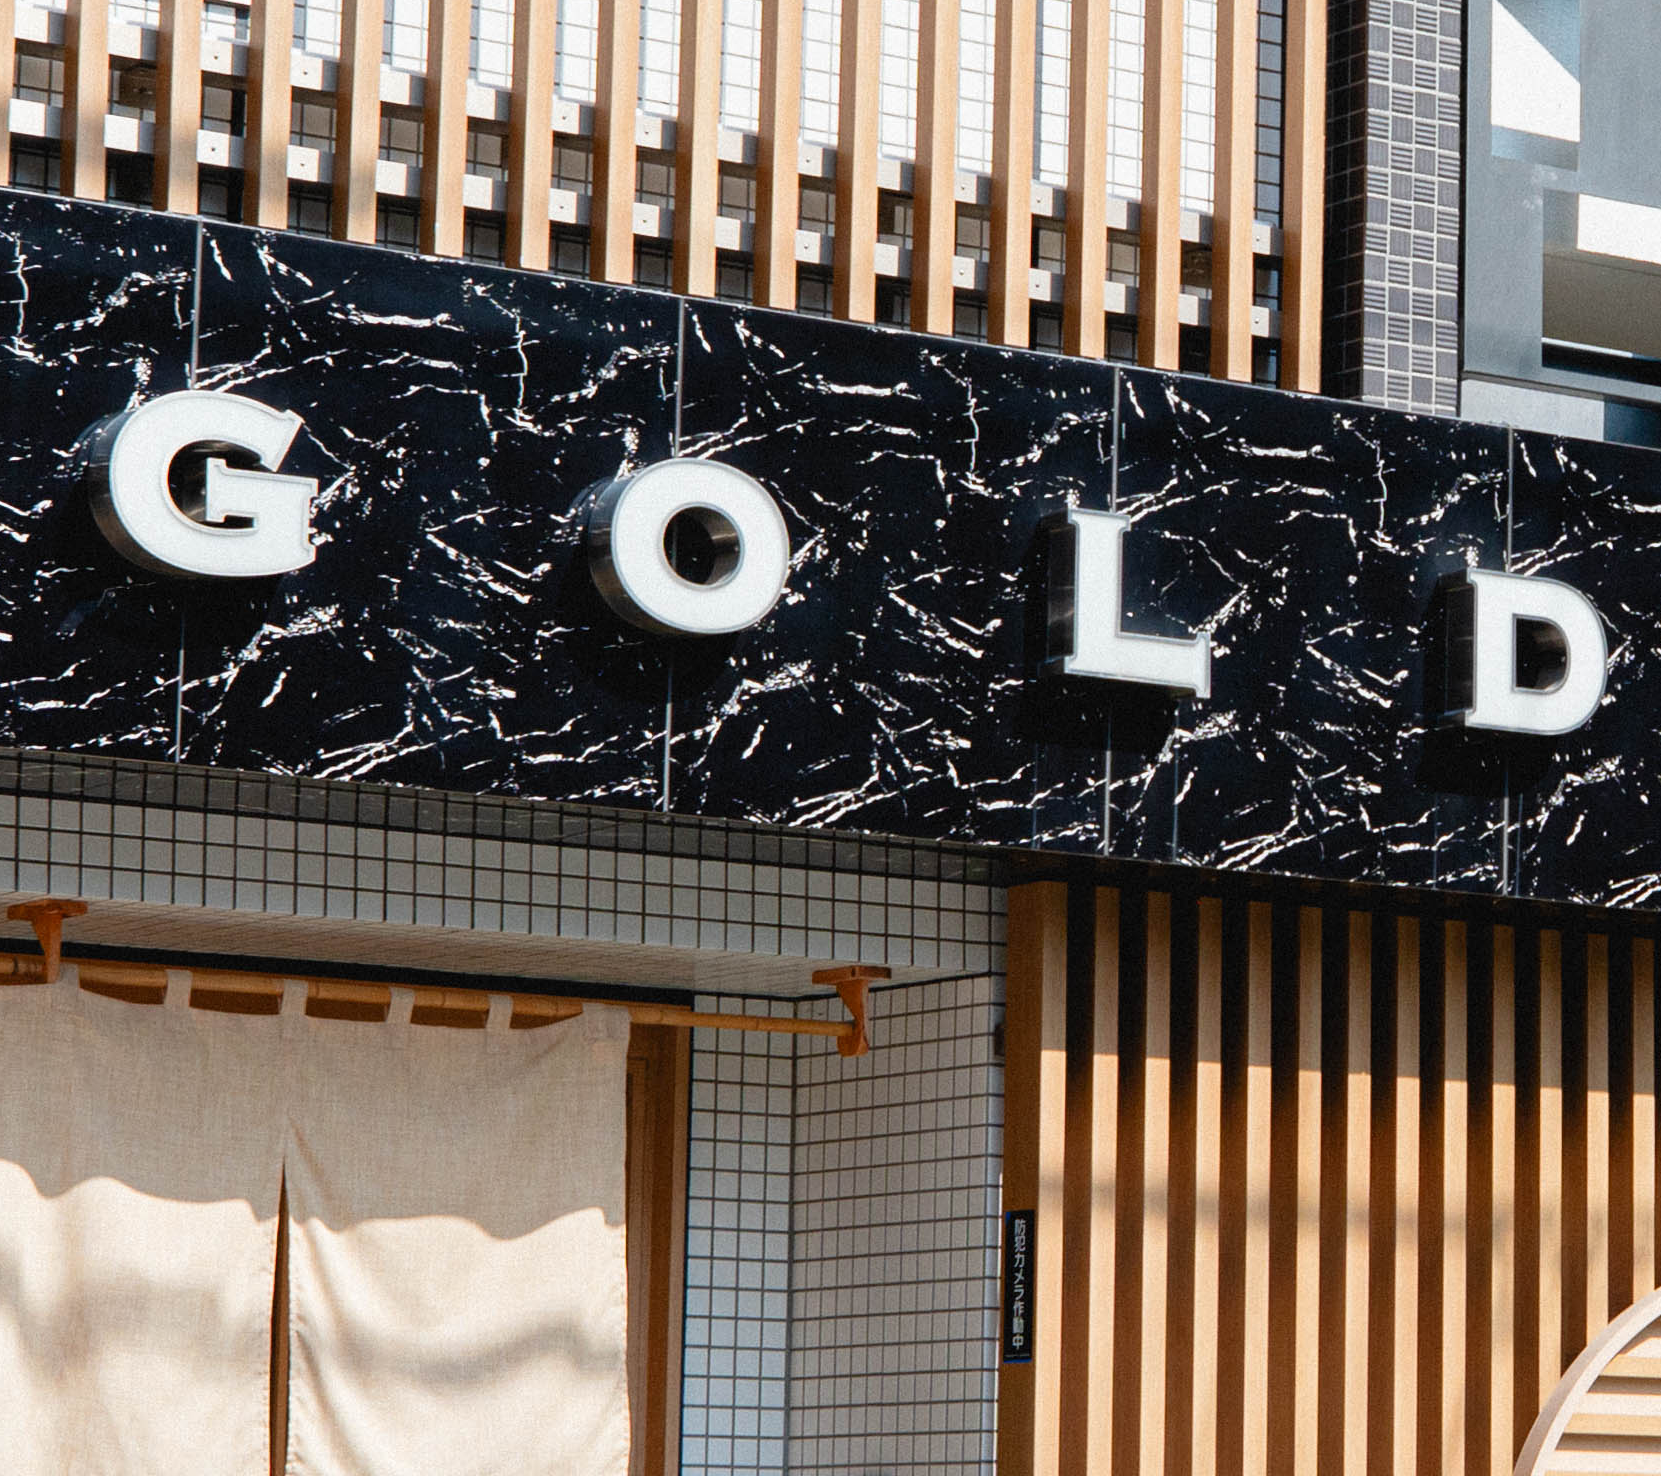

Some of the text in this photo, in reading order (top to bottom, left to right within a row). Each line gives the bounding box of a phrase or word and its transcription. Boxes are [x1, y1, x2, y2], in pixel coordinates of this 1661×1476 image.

[1012, 1218, 1026, 1351] 防犯カメラ作動中
